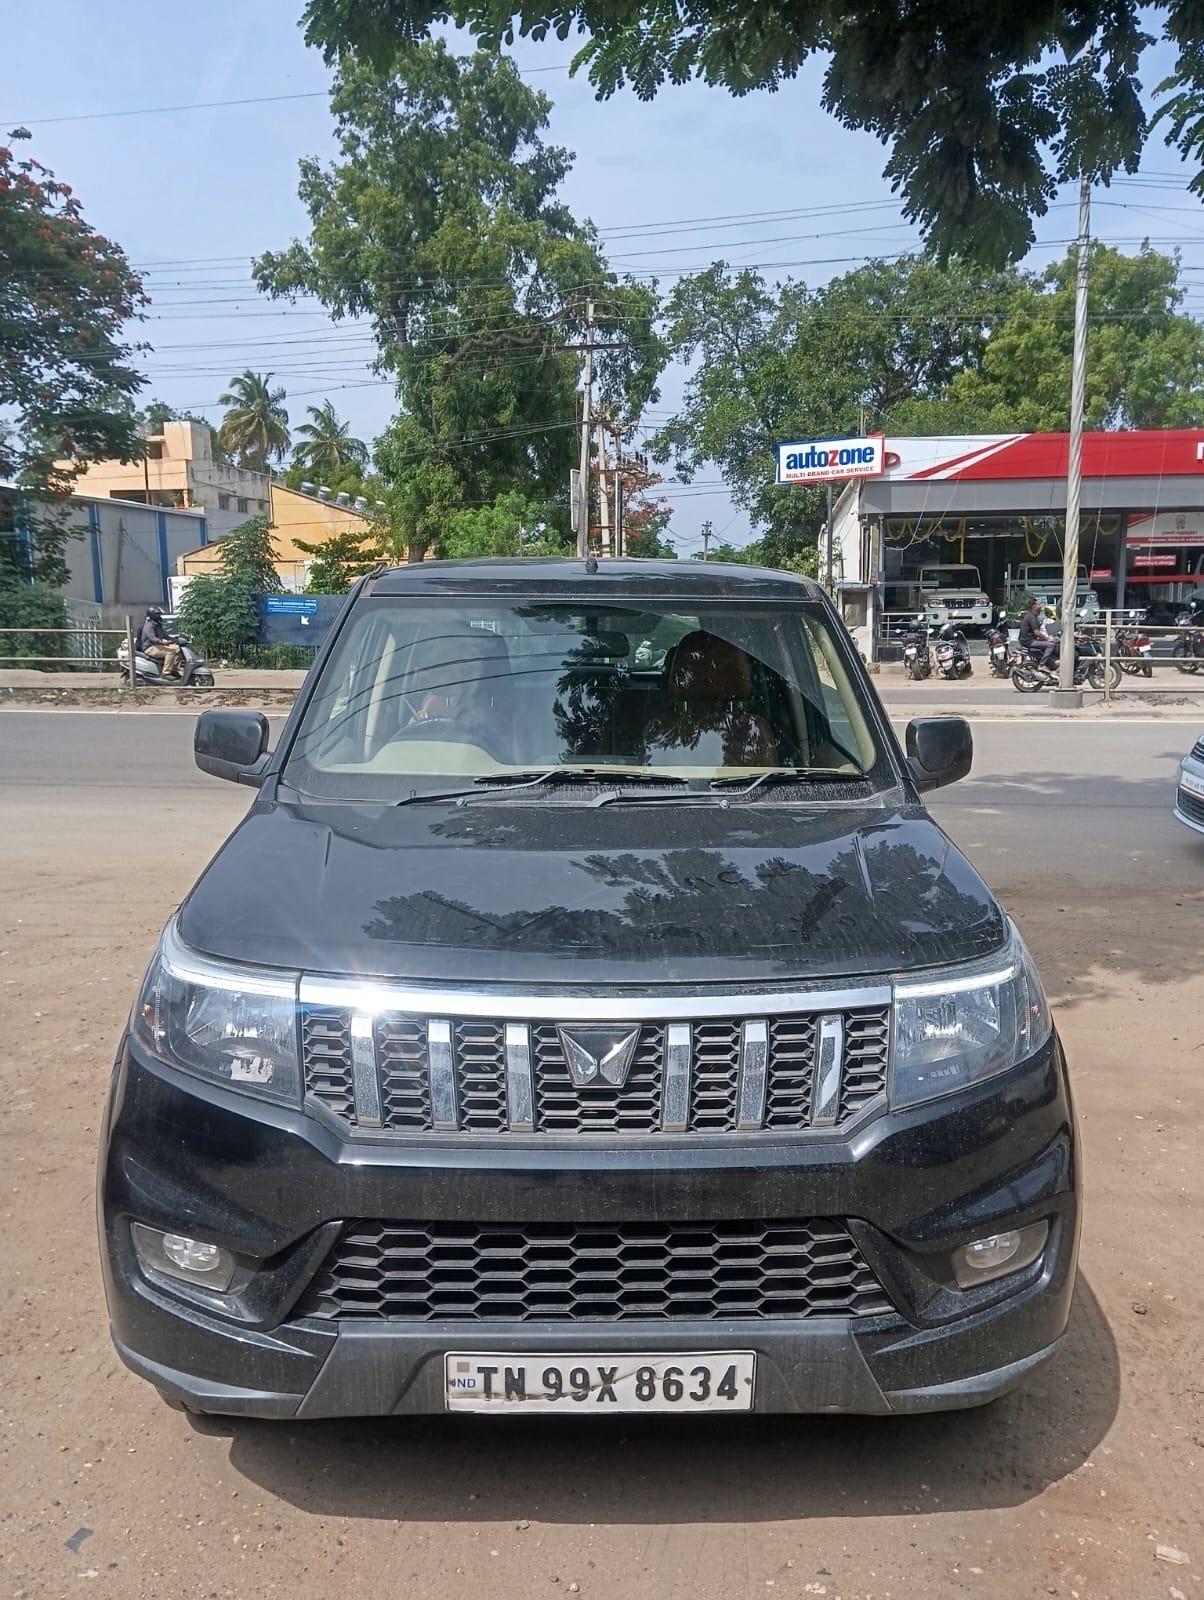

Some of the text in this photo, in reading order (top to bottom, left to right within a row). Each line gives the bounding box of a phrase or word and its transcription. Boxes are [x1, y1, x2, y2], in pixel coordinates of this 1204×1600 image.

[785, 445, 875, 470] autozone
[846, 465, 875, 474] SERVICE
[476, 1365, 738, 1402] TN 99X 8634
